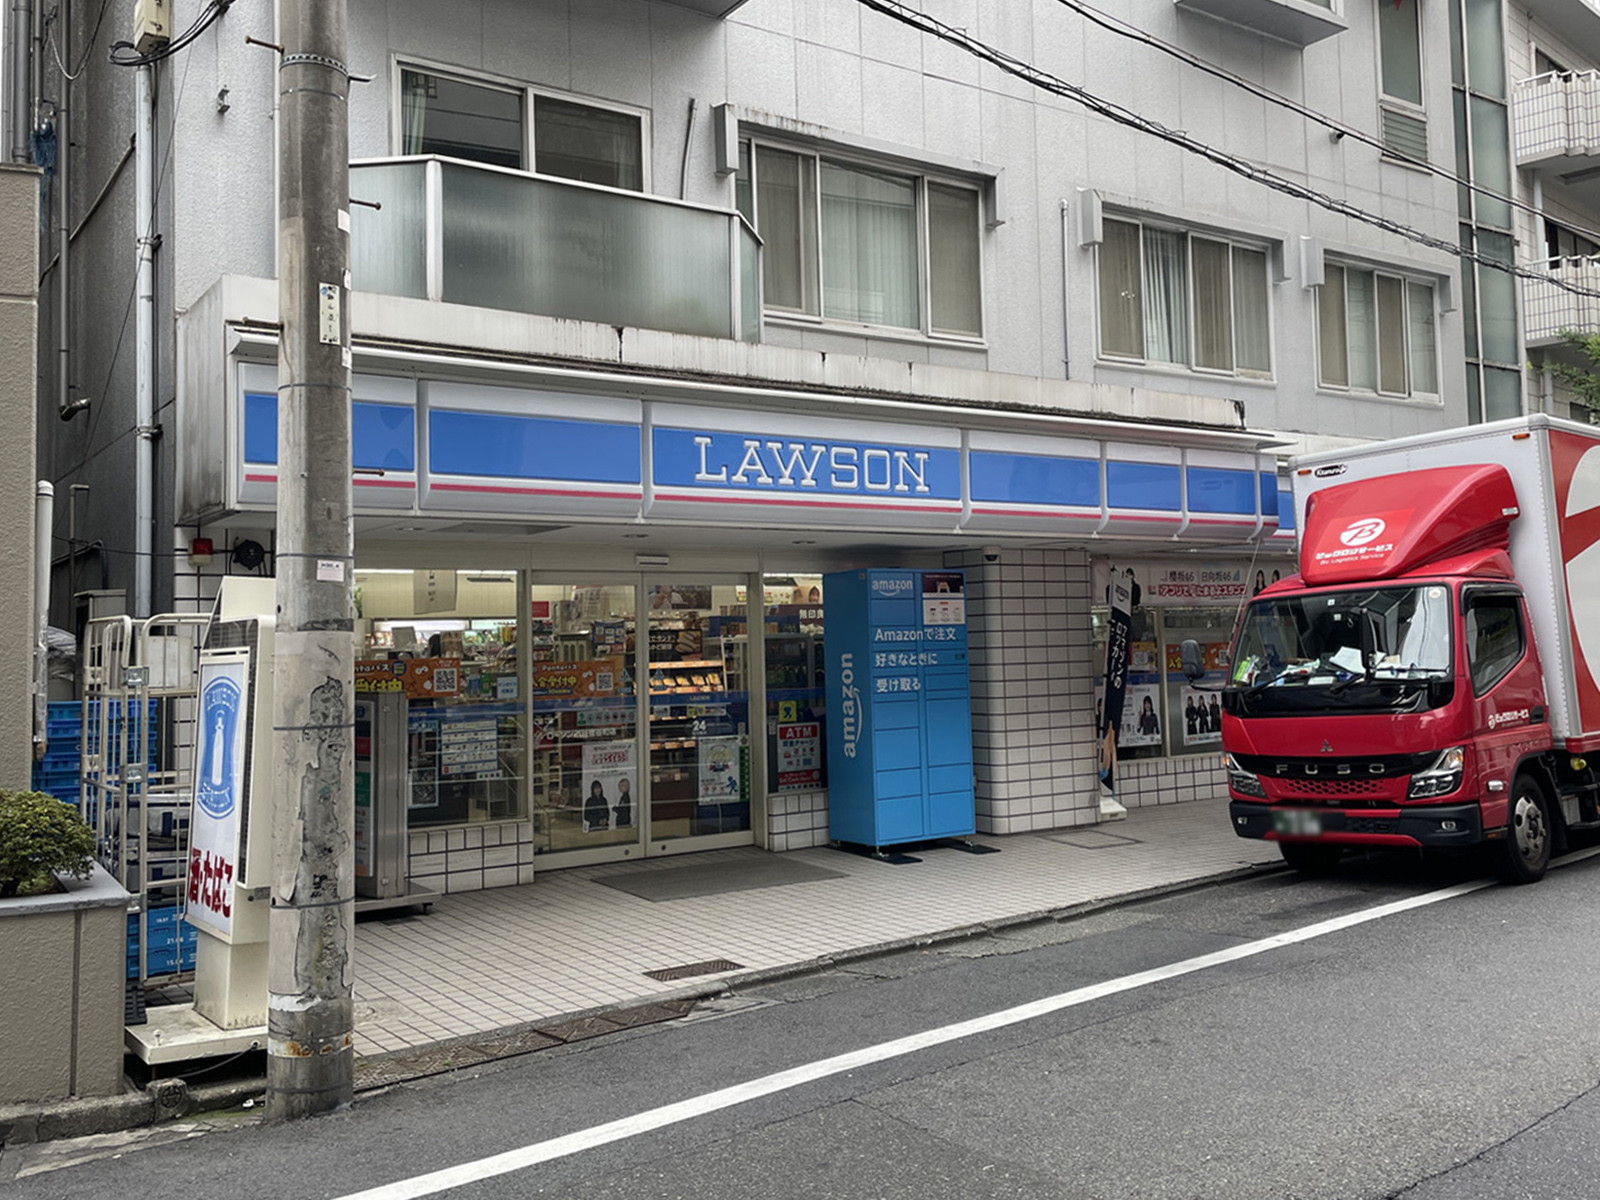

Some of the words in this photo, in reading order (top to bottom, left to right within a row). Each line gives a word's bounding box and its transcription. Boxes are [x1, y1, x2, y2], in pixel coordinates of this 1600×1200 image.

[694, 436, 930, 493] LAWSON
[1315, 544, 1393, 560] ビックロジサービス
[872, 579, 913, 591] amazon
[874, 627, 956, 642] Amazonで注文
[875, 653, 938, 667] 好きなときに
[877, 678, 921, 693] 受け取る
[841, 653, 858, 758] amazon
[692, 719, 707, 731] 24
[786, 726, 812, 739] ATM
[1276, 763, 1385, 775] FUSO
